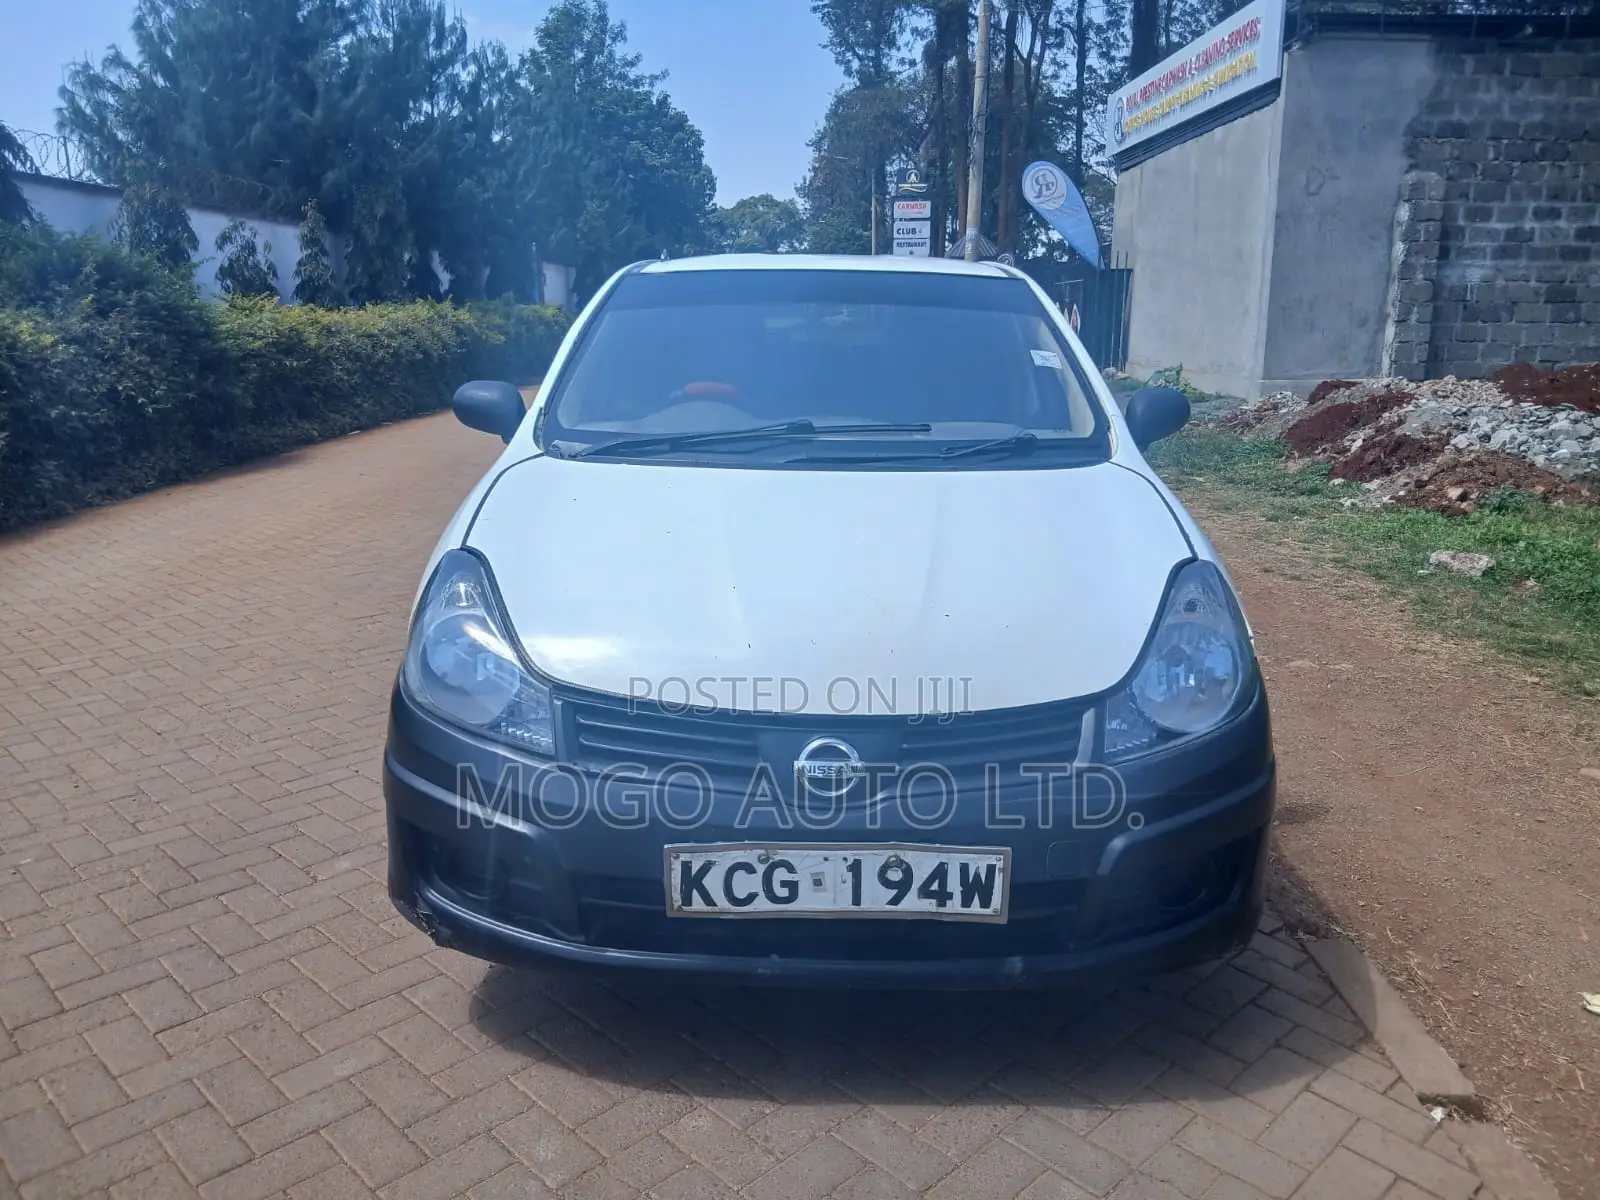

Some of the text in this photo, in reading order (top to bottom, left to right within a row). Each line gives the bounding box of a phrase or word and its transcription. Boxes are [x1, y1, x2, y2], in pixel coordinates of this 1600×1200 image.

[896, 227, 917, 235] CLUB
[799, 763, 864, 776] NISSAN
[679, 857, 998, 909] KCG 194W
